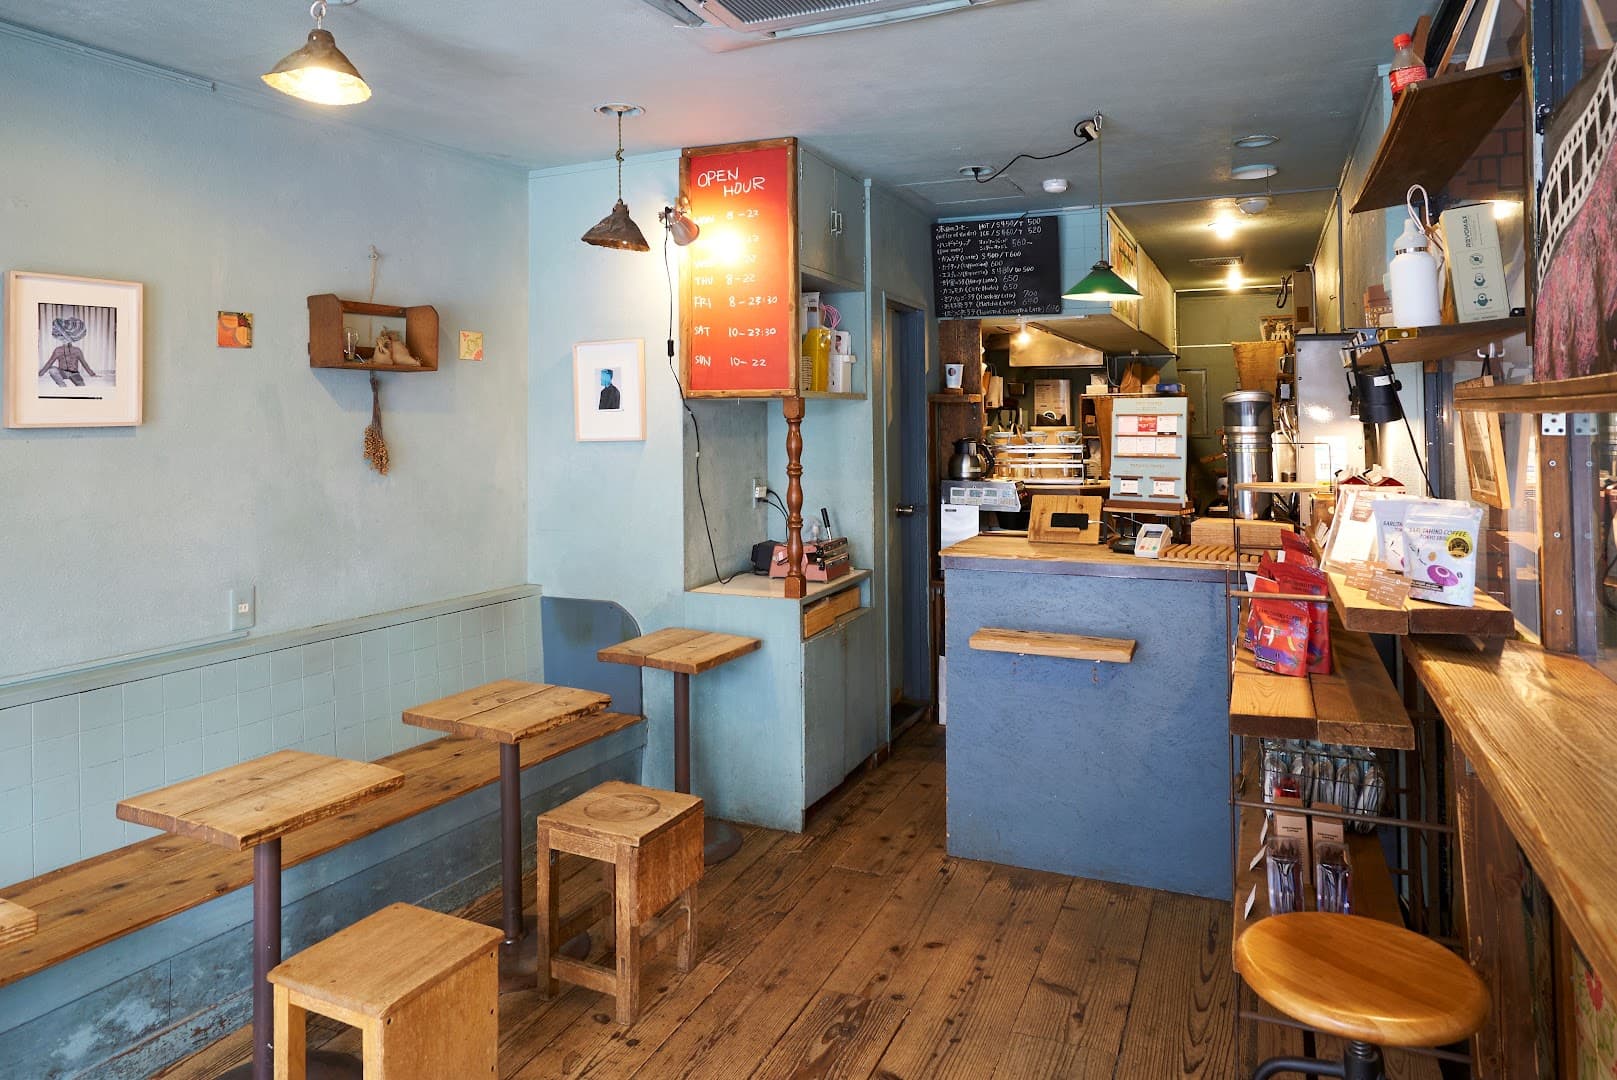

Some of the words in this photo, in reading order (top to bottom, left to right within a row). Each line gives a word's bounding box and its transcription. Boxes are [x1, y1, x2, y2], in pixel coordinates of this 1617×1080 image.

[697, 166, 740, 187] OPEN
[723, 176, 766, 197] HOUR
[1027, 218, 1041, 226] 500
[1027, 226, 1042, 234] 520
[1002, 274, 1019, 283] 650
[1002, 283, 1018, 291] 650
[694, 295, 712, 309] FRI
[694, 325, 711, 337] SAT
[694, 354, 711, 367] SUN
